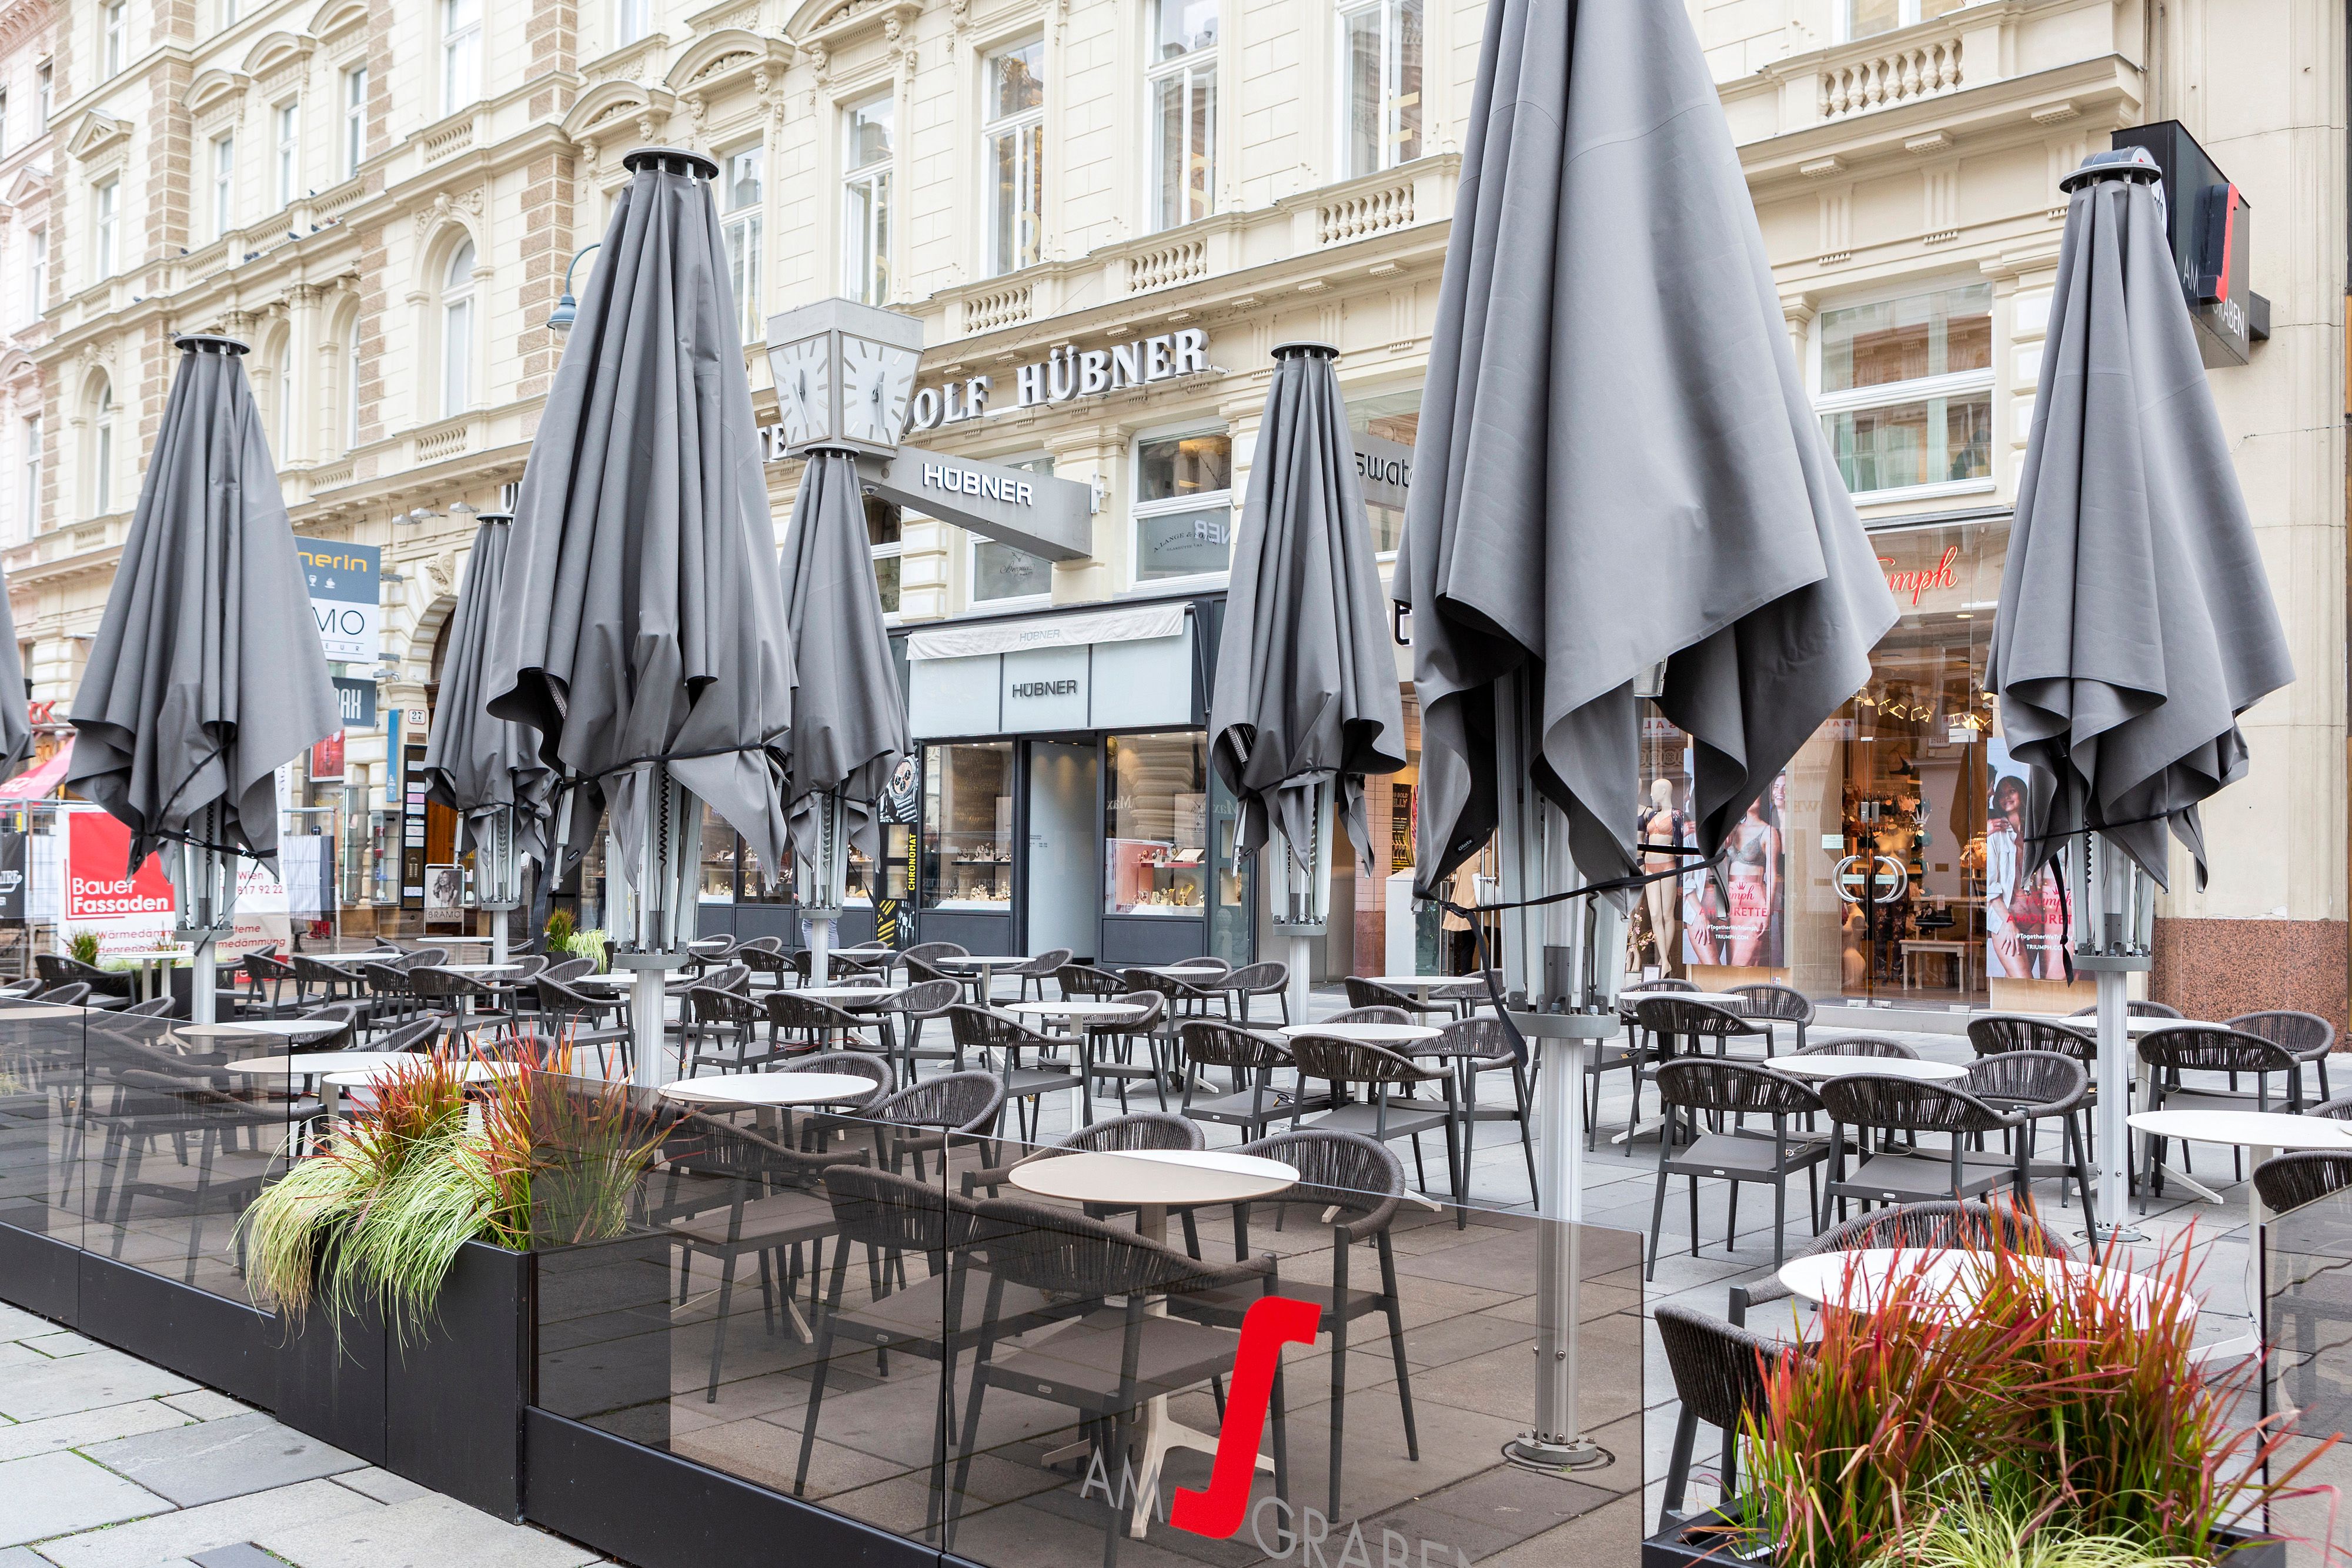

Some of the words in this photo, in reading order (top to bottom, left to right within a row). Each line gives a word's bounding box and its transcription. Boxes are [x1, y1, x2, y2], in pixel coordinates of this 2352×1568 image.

[904, 375, 993, 431] OLF
[1016, 328, 1210, 409] HÜBNER
[1354, 451, 1412, 489] swat
[922, 462, 1033, 506] HÜBNER
[1019, 629, 1060, 642] HÜBNER
[1012, 679, 1077, 698] HÜBNER
[412, 711, 422, 720] 27
[1458, 839, 1473, 851] Glatz
[907, 833, 917, 891] CHRONOMAT
[238, 871, 263, 880] Wien
[72, 877, 136, 895] Bauer
[237, 885, 255, 895] 817
[259, 885, 270, 894] 92
[273, 885, 283, 894] 22
[73, 895, 169, 913] Fassaden
[1699, 906, 1768, 917] AMRETTE
[428, 911, 461, 919] BRAMO
[1080, 1446, 1164, 1524] AM
